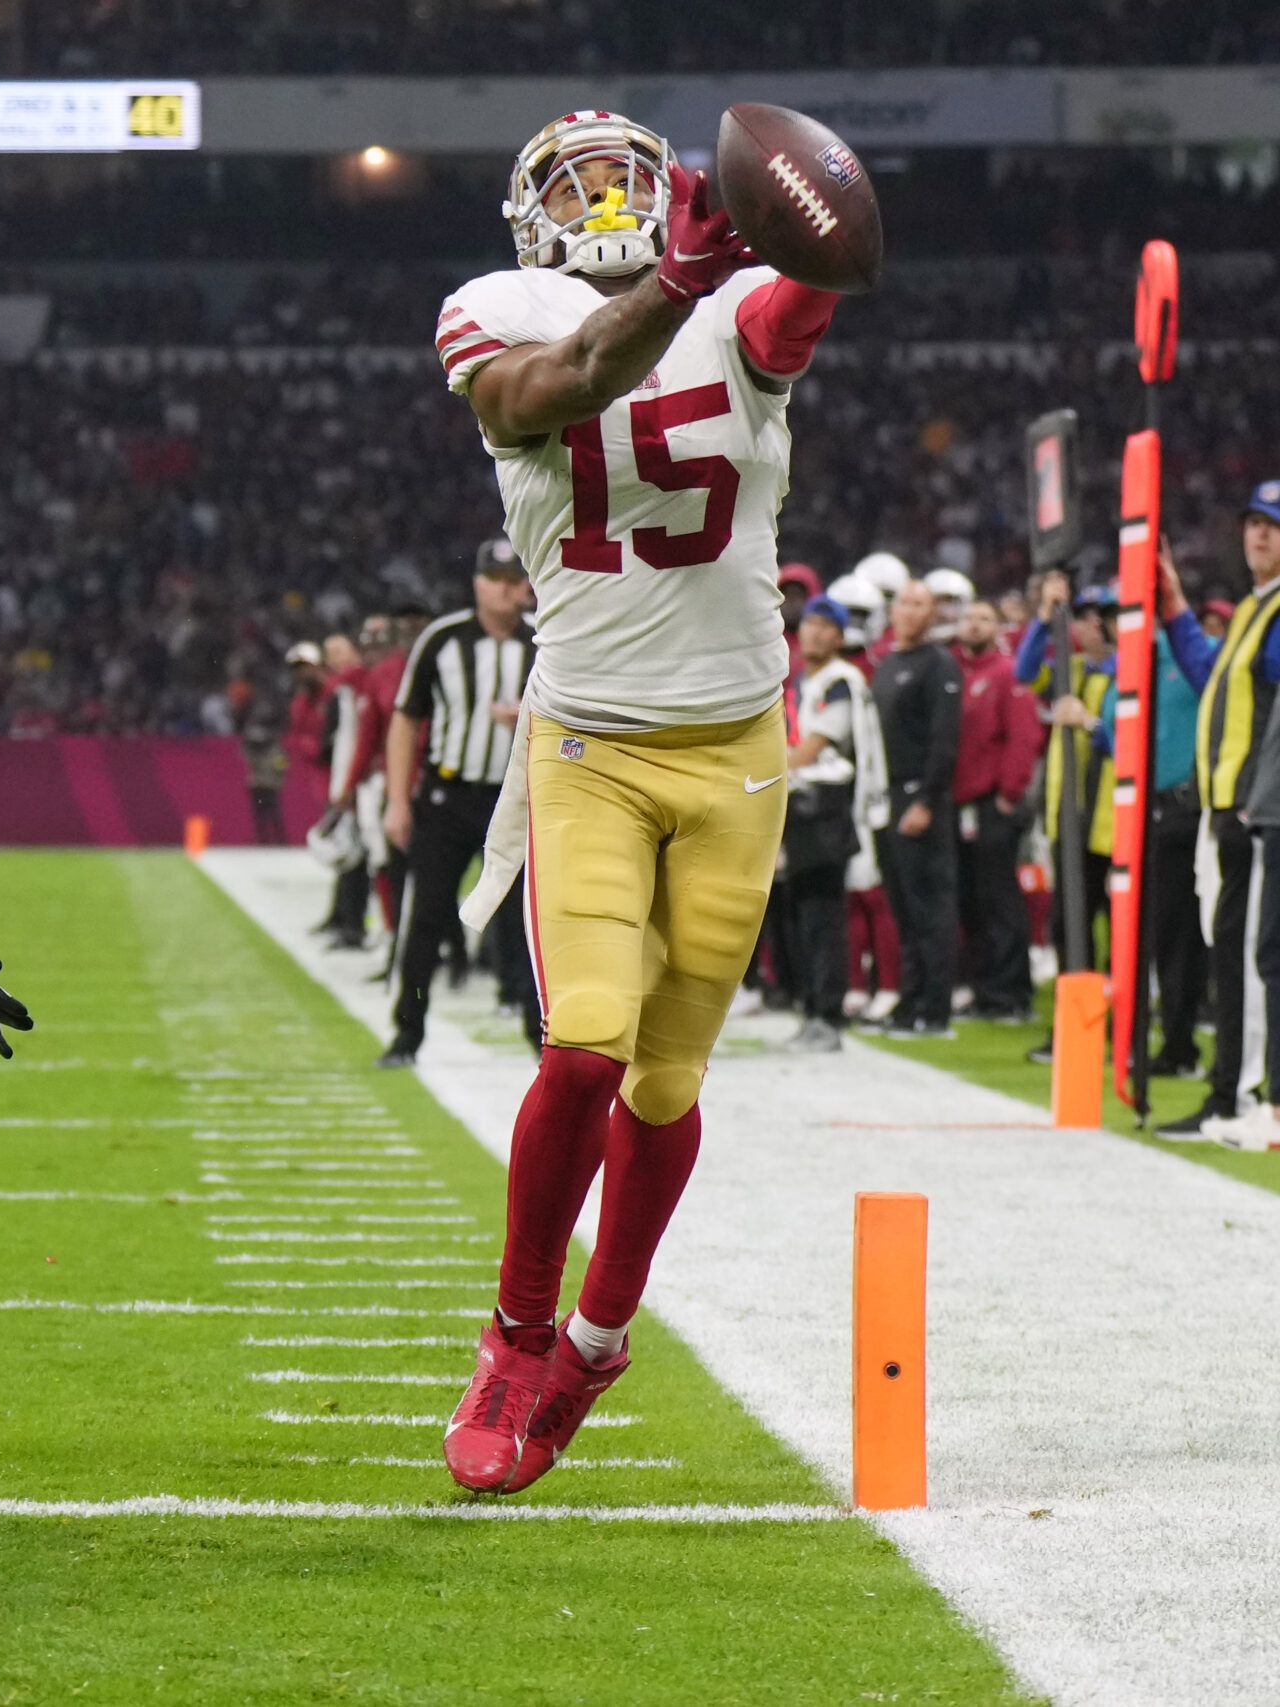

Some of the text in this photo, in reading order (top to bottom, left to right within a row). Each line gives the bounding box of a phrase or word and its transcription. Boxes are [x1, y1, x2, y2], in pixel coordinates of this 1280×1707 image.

[128, 96, 184, 136] 40
[560, 381, 740, 574] 15
[564, 746, 582, 757] NFL
